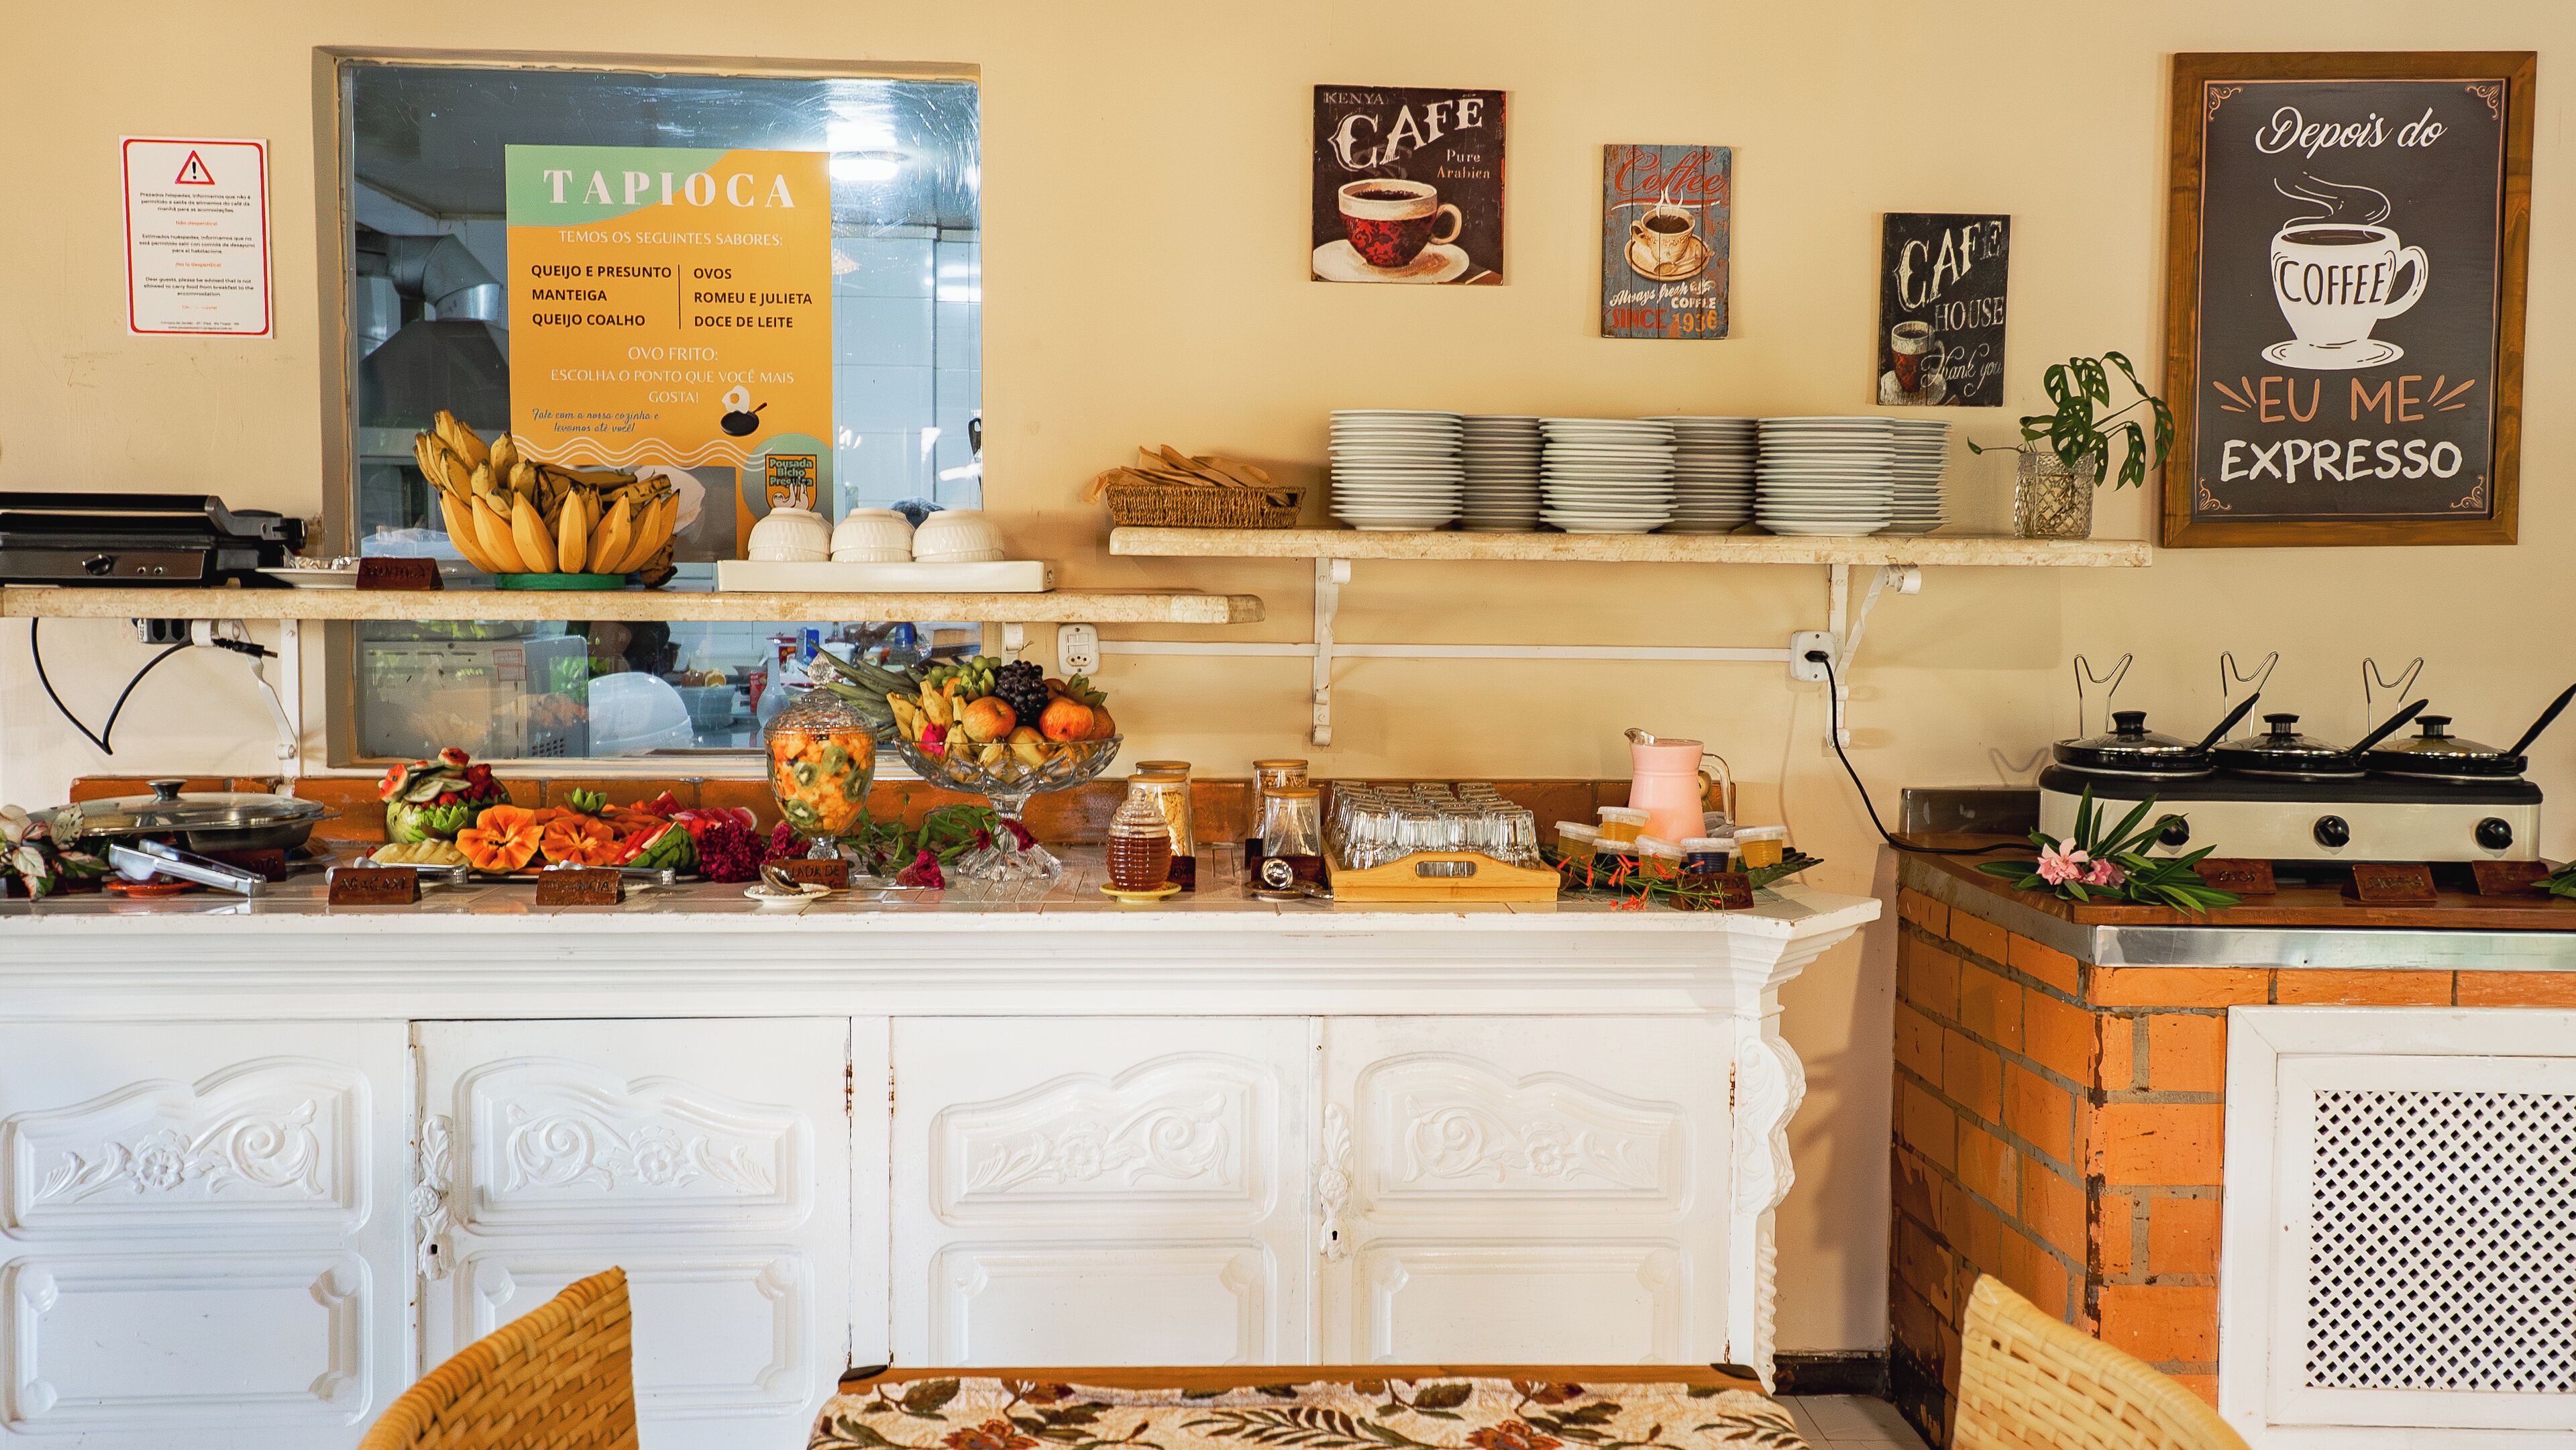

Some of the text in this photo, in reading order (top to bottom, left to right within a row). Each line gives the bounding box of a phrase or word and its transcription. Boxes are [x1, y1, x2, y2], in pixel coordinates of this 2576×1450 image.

[1323, 91, 1385, 105] KENYA
[1328, 99, 1484, 172] CAFE
[2255, 106, 2448, 159] Depois do
[1446, 149, 1481, 163] Pure
[1615, 148, 1727, 195] Coffee
[543, 169, 796, 209] TAPIOCA
[558, 230, 783, 246] TEMOS OS SEGUINTES SABORES:
[531, 265, 672, 279] QUEIJO E PRESUNTO
[693, 268, 732, 279] OVOS
[2279, 259, 2386, 306] COFFEE
[532, 289, 607, 301] MANTEIGA
[694, 292, 812, 306] ROMEU E JULIETA
[1609, 289, 1656, 307] Always
[1657, 282, 1688, 305] fresh
[532, 313, 645, 327] QUEIJO COALHO
[1611, 308, 1667, 329] SINCE
[1934, 296, 2005, 332] HOUSE
[694, 316, 793, 329] DOCE DE LEITE
[628, 346, 718, 362] OVO FRITO:
[551, 368, 794, 385] ESCOLHA O PONTO QUE VOCÊ MAIS
[649, 391, 699, 403] GOSTA!
[2260, 375, 2424, 424] EU ME
[532, 407, 552, 421] Fale
[555, 411, 574, 420] com
[586, 412, 612, 420] nossa
[614, 410, 651, 425] cozinha
[594, 421, 609, 432] até
[769, 458, 813, 468] Pousada
[2220, 439, 2462, 483] EXPRESSO
[777, 467, 806, 477] Bicho
